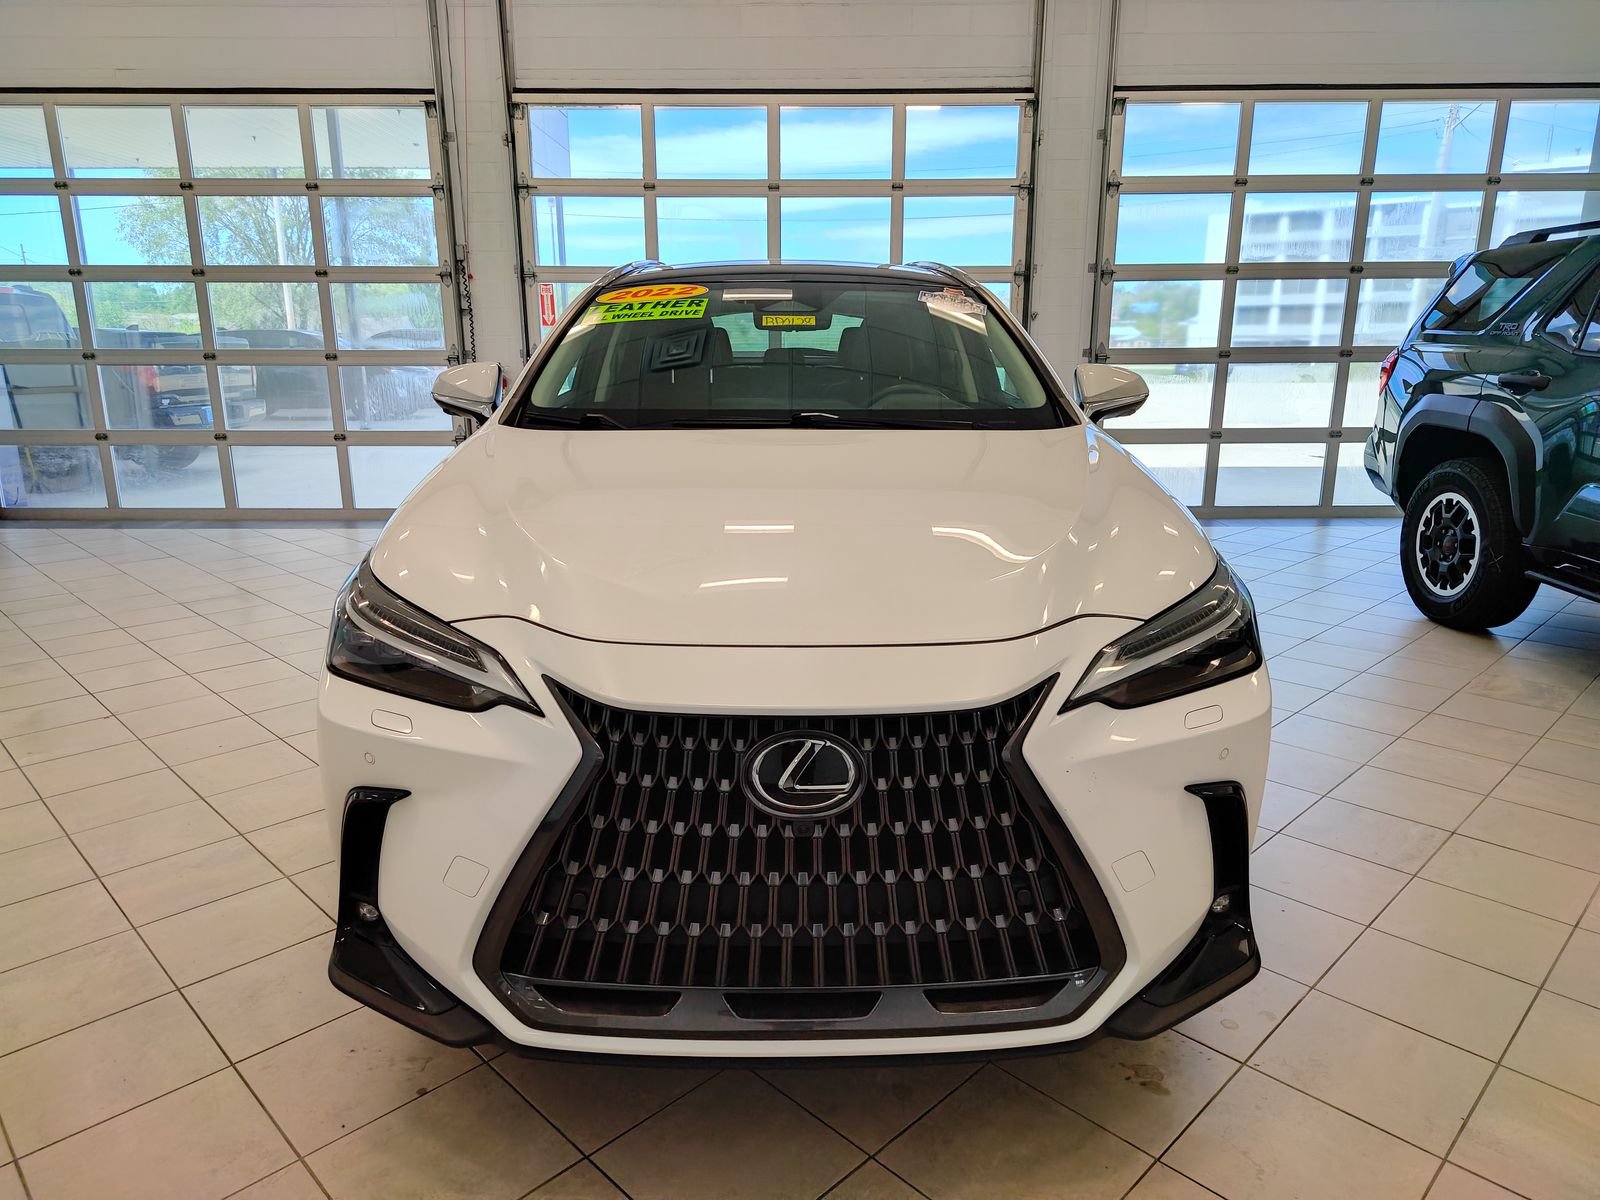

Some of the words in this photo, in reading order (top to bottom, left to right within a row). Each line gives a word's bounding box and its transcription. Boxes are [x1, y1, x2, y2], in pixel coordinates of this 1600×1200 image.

[607, 286, 699, 301] 2022
[592, 299, 705, 315] EATHER
[611, 311, 655, 320] WHEEL
[659, 309, 703, 317] DRIVE
[1500, 322, 1519, 331] TRD
